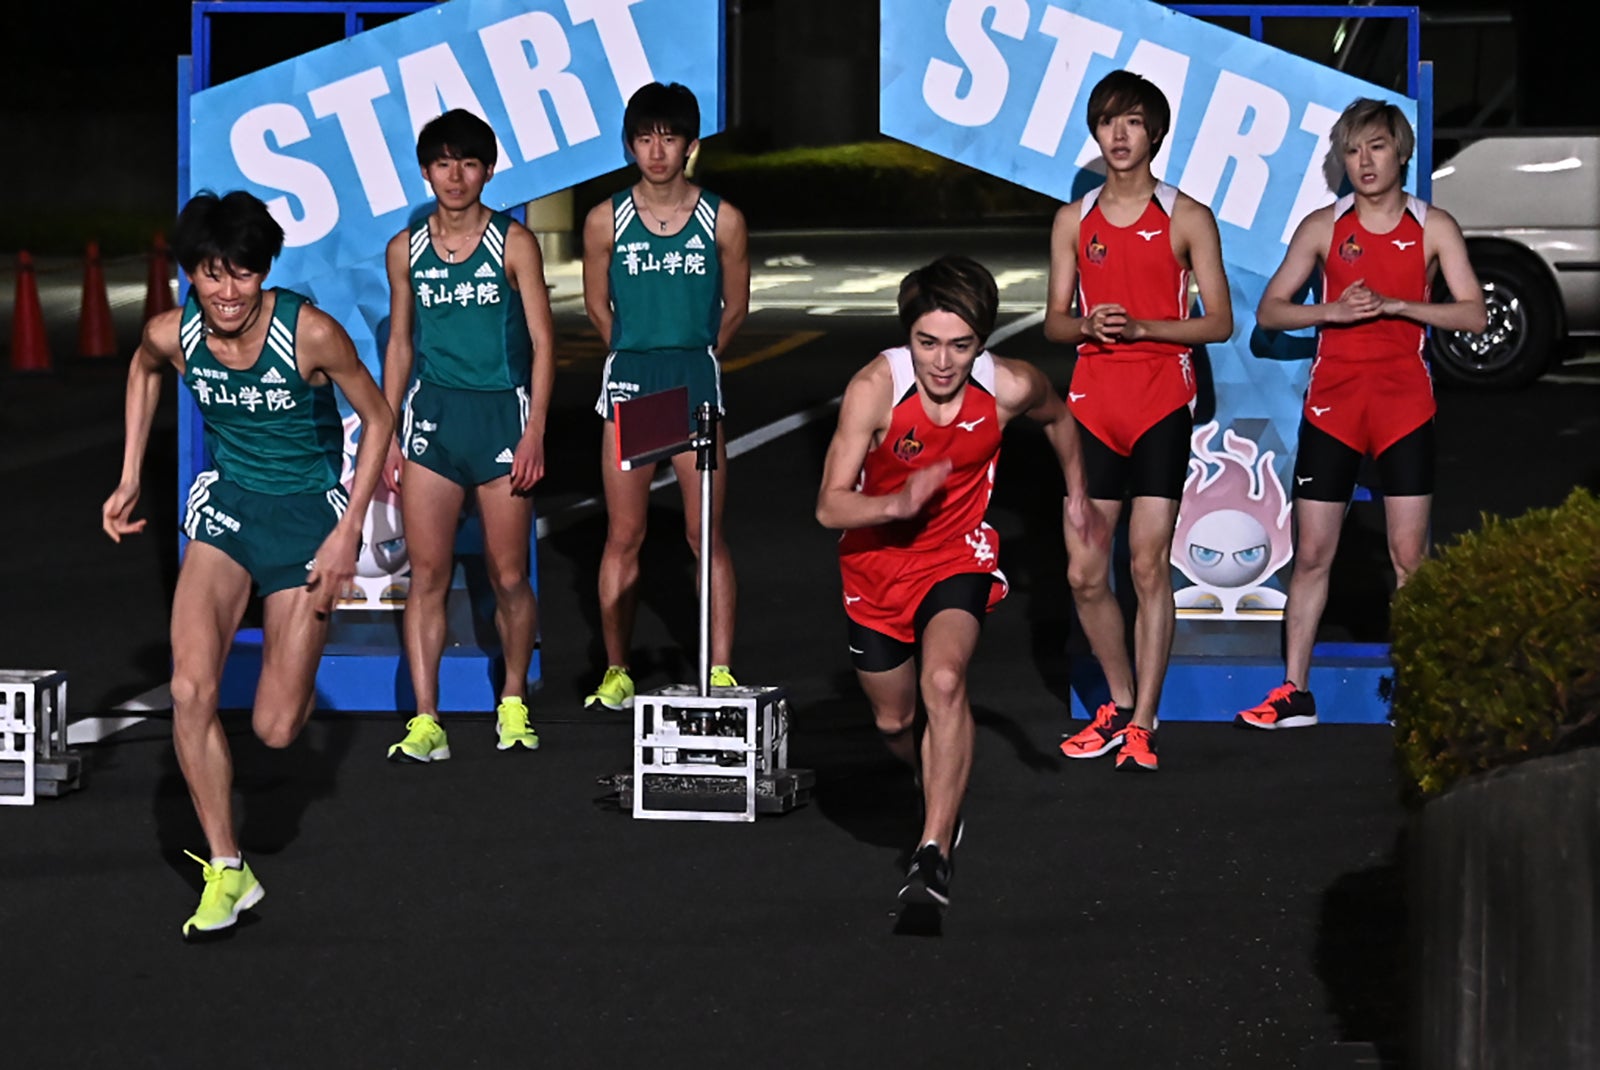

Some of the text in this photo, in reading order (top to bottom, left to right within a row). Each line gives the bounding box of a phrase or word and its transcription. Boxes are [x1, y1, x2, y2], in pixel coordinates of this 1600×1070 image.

[622, 251, 706, 275] 青山学院
[417, 281, 500, 307] 青山学院
[192, 378, 297, 412] 青山学院
